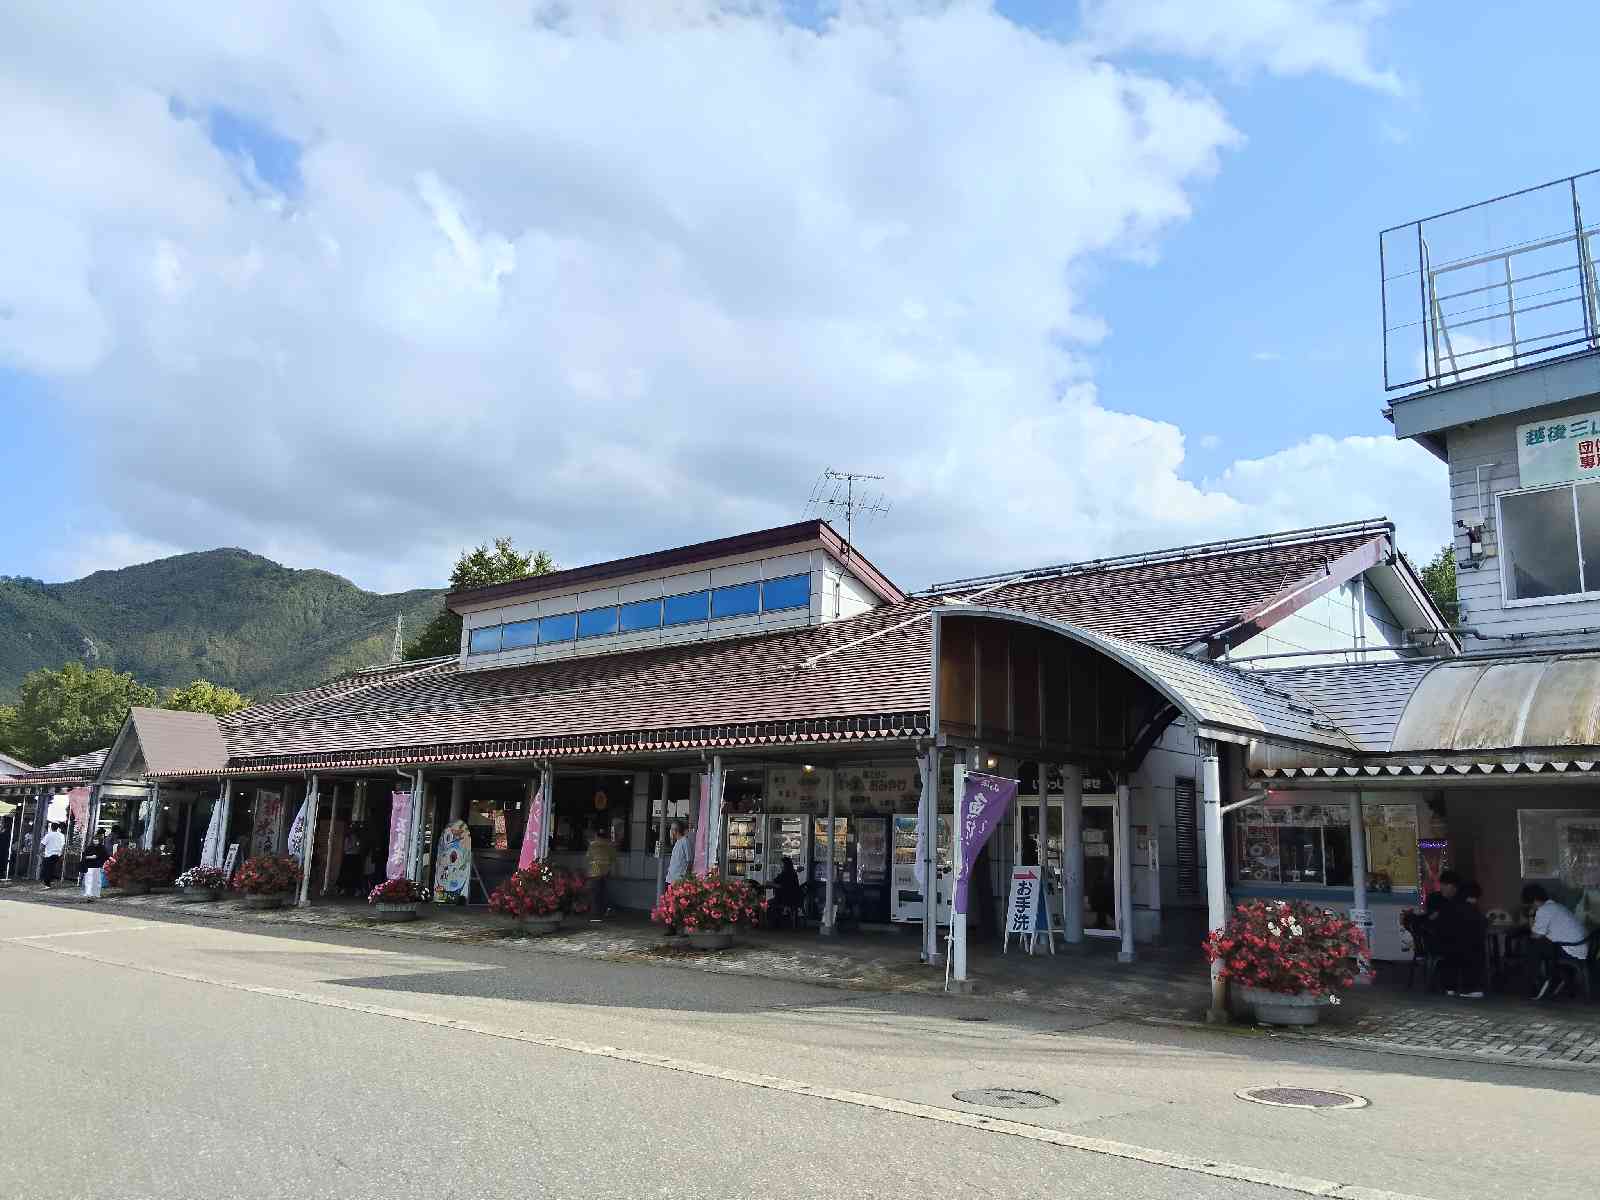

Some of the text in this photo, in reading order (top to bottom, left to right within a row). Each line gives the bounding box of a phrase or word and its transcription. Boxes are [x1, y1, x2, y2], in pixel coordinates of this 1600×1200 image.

[1579, 438, 1600, 456] 団
[1012, 879, 1033, 931] お手洗
